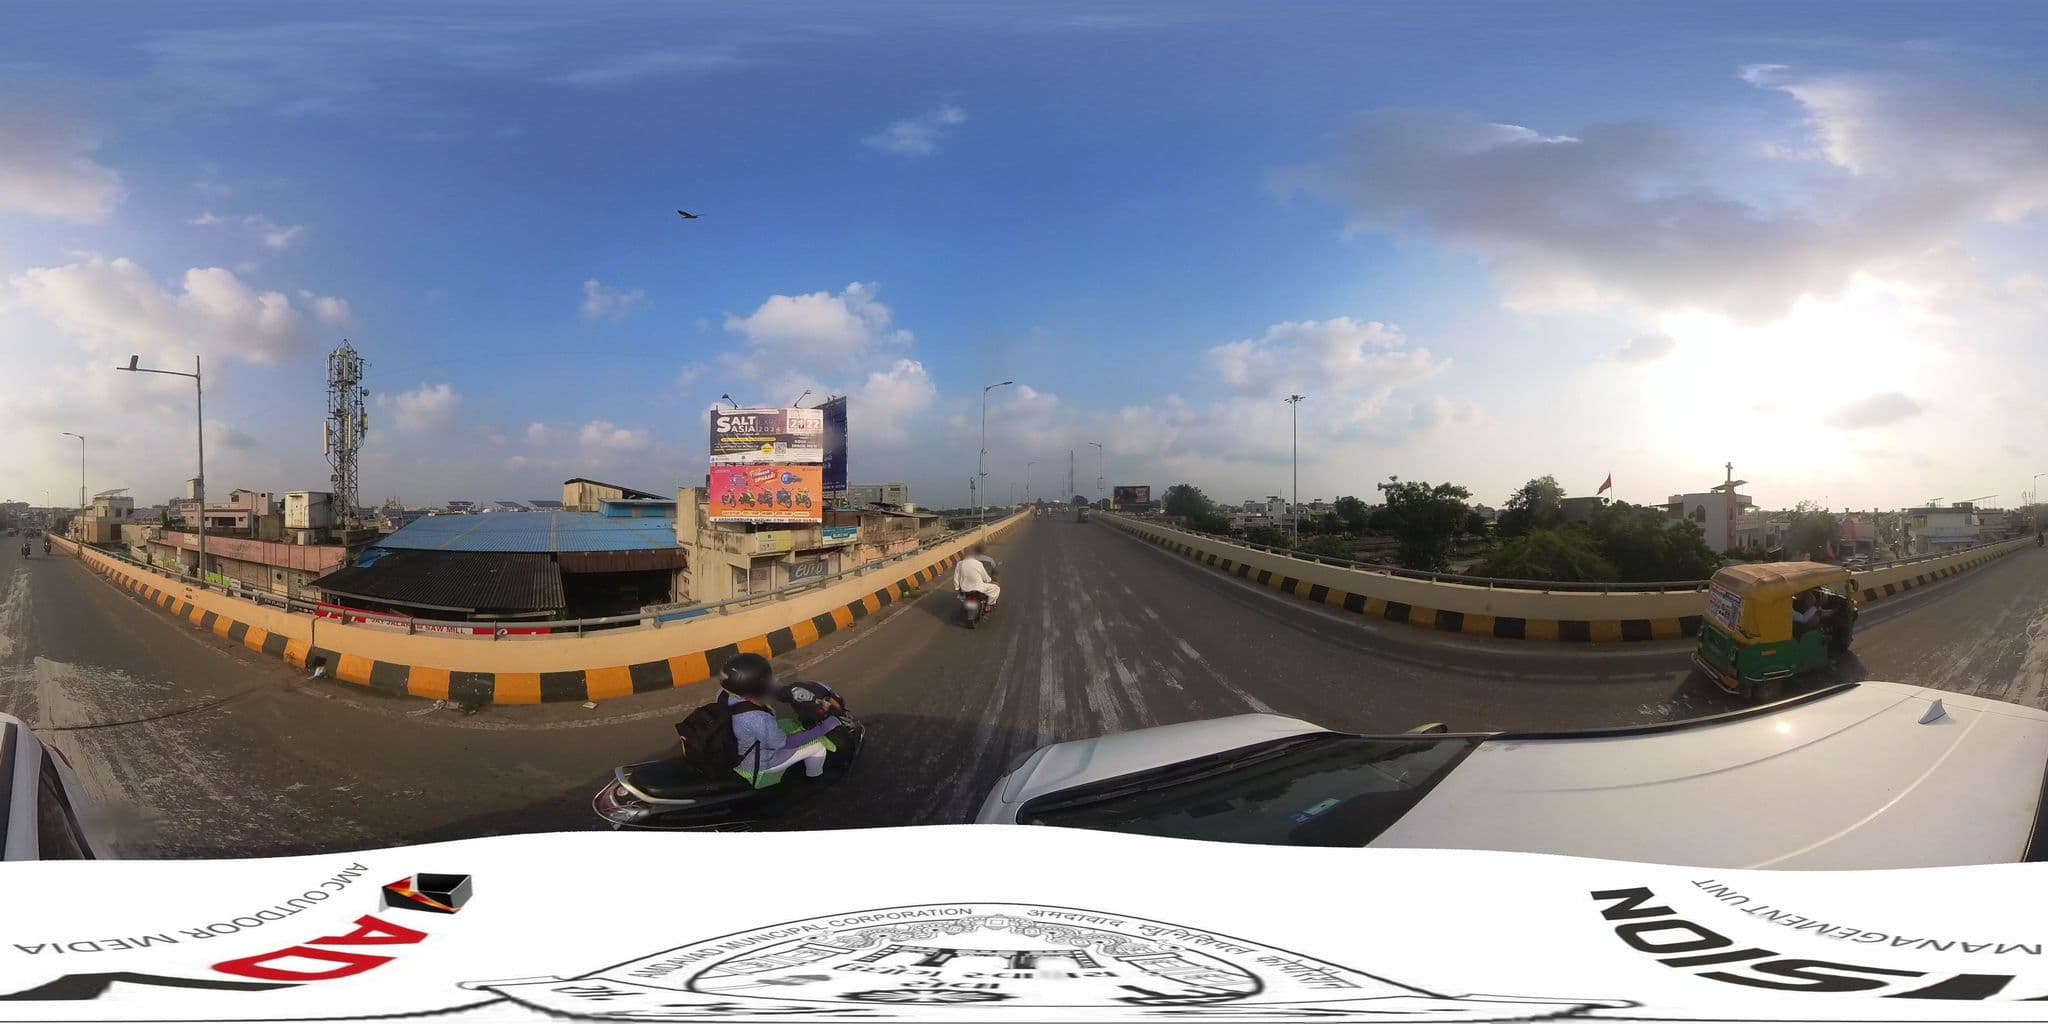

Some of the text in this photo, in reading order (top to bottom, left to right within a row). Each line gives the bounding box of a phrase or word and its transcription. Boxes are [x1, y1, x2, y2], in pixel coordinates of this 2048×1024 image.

[717, 416, 756, 433] SALT
[731, 425, 756, 433] ASIA
[425, 624, 444, 632] SAW
[446, 625, 465, 634] MILL
